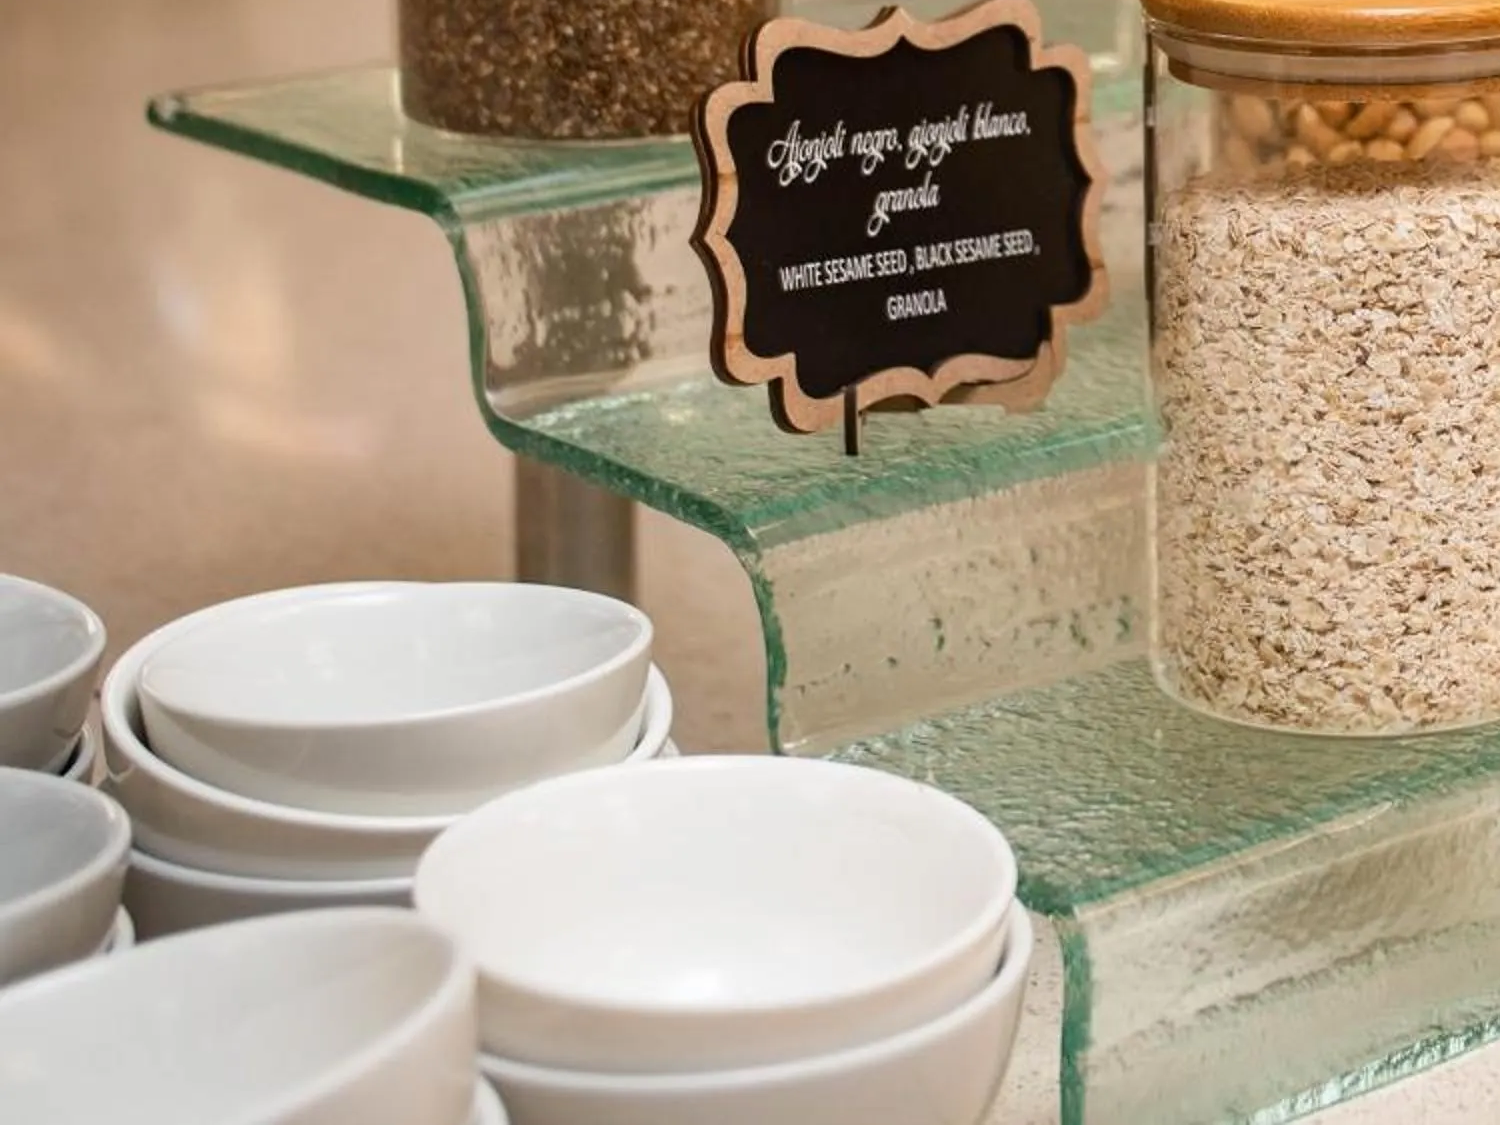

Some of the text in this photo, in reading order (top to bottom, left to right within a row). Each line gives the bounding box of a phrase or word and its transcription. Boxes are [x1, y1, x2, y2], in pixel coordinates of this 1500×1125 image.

[850, 128, 903, 175] negro,
[972, 101, 1031, 141] blanco,
[866, 171, 941, 237] granola
[779, 261, 823, 292] WHITE
[824, 256, 875, 285] SESAME
[915, 242, 955, 271] BLACK
[955, 233, 1002, 264] SESAME
[886, 288, 948, 321] GRANOLA
